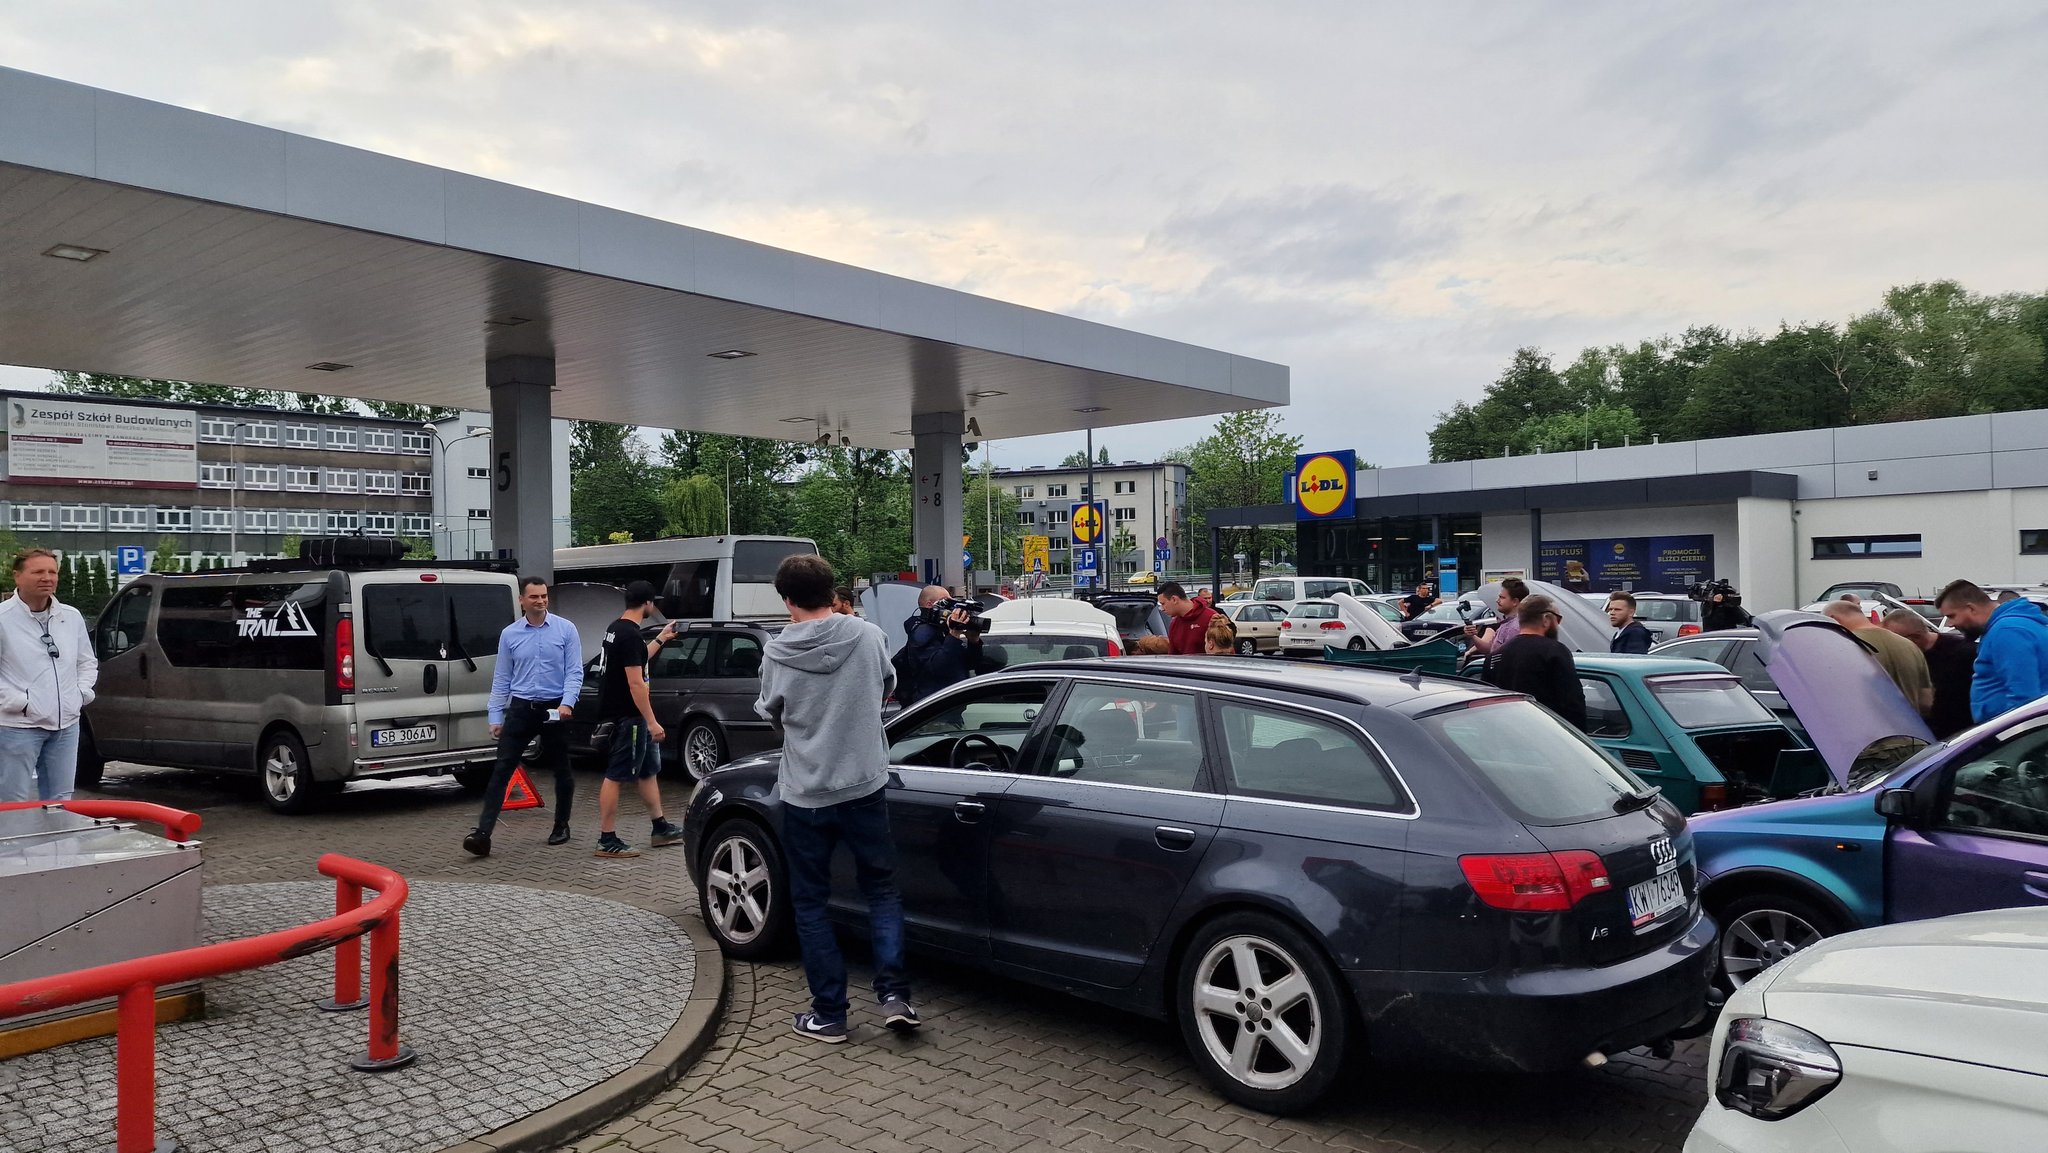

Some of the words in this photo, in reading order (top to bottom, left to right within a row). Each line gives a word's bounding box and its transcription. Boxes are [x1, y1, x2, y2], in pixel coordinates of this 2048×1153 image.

[31, 409, 74, 420] Zespół
[78, 412, 111, 422] Szkół
[116, 415, 192, 428] Budowlanych
[498, 452, 511, 492] 5
[933, 473, 941, 488] 7
[933, 492, 941, 506] 8
[124, 549, 138, 566] P
[1086, 552, 1094, 567] P
[1155, 562, 1160, 570] P
[246, 608, 264, 618] THE
[236, 619, 281, 641] TRAIL
[381, 731, 396, 742] SB
[400, 728, 433, 741] 306AV
[1631, 884, 1654, 915] KWI
[1652, 870, 1680, 906] 76349
[1592, 926, 1608, 940] A6
